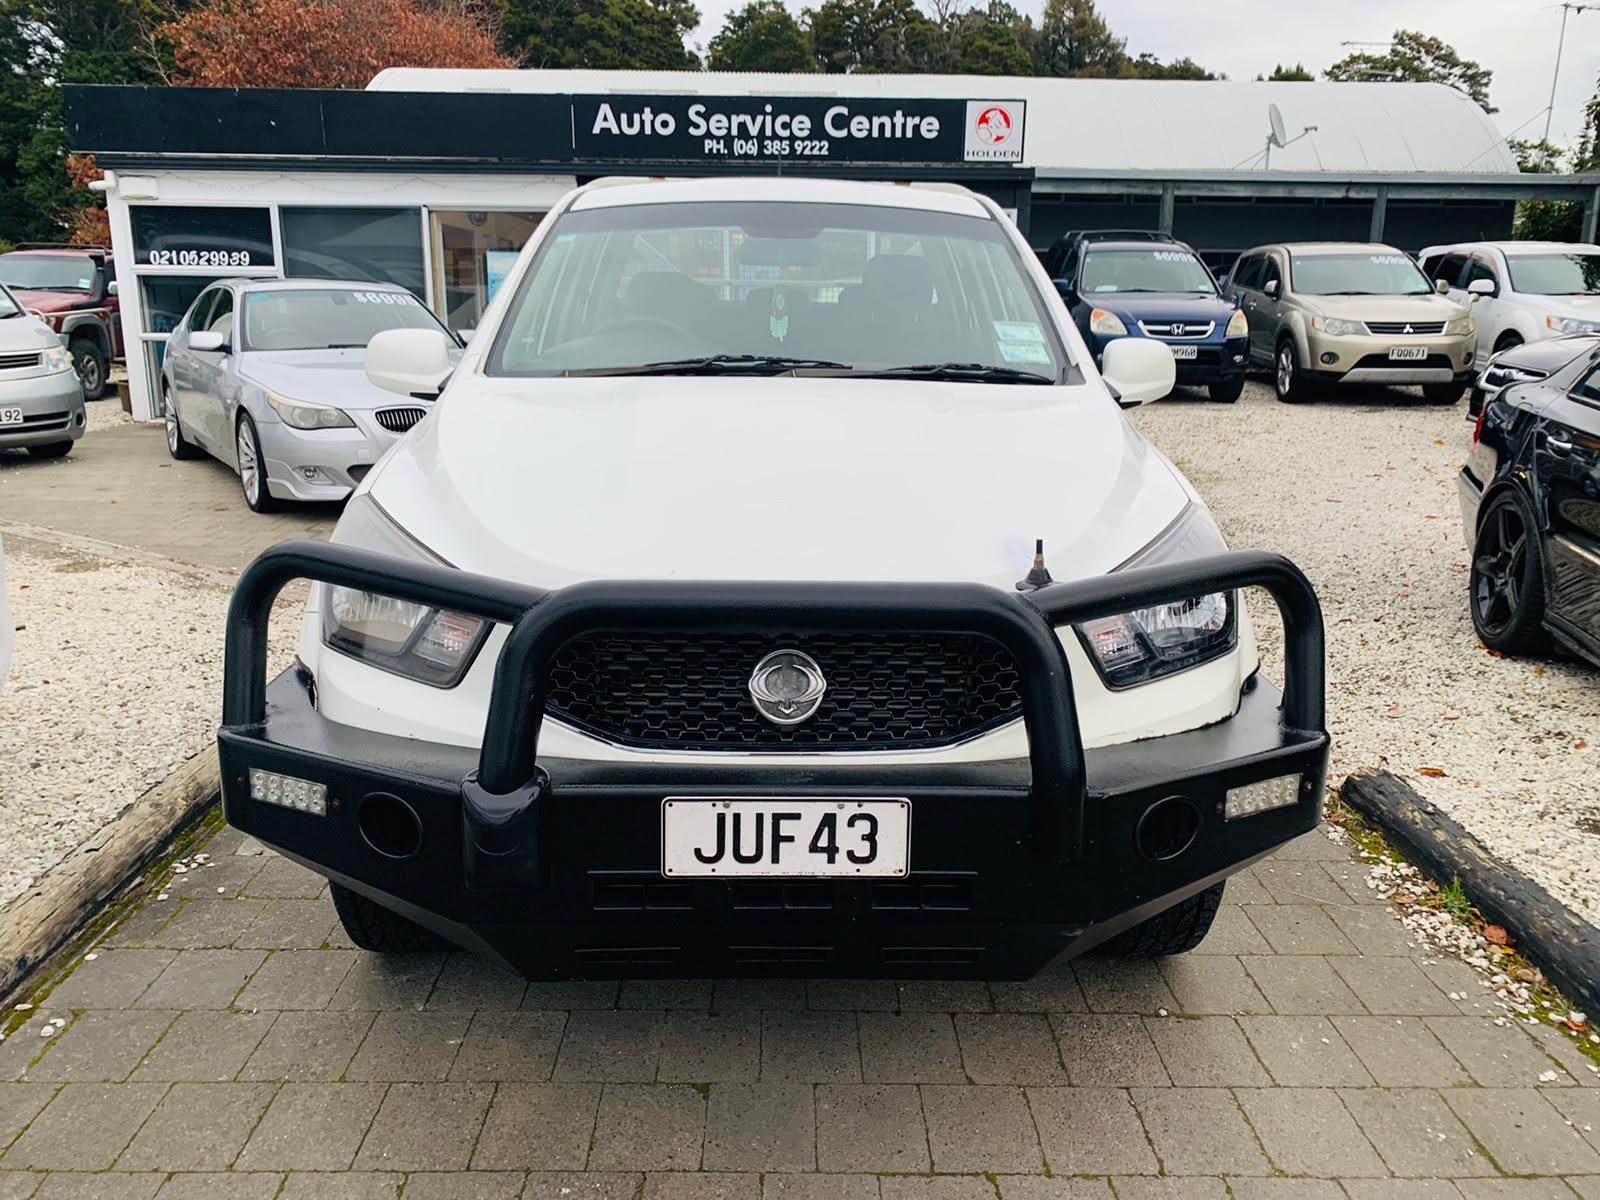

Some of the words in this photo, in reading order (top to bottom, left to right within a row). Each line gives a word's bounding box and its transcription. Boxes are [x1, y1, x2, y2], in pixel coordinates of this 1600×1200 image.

[592, 103, 676, 136] Auto
[688, 104, 811, 137] Service
[824, 105, 940, 139] Centre
[704, 139, 728, 154] PH.
[733, 138, 758, 156] (06)
[763, 140, 790, 155] 385
[794, 140, 829, 155] 9222
[966, 150, 1020, 158] HOLDEN
[693, 812, 879, 865] JUF43
